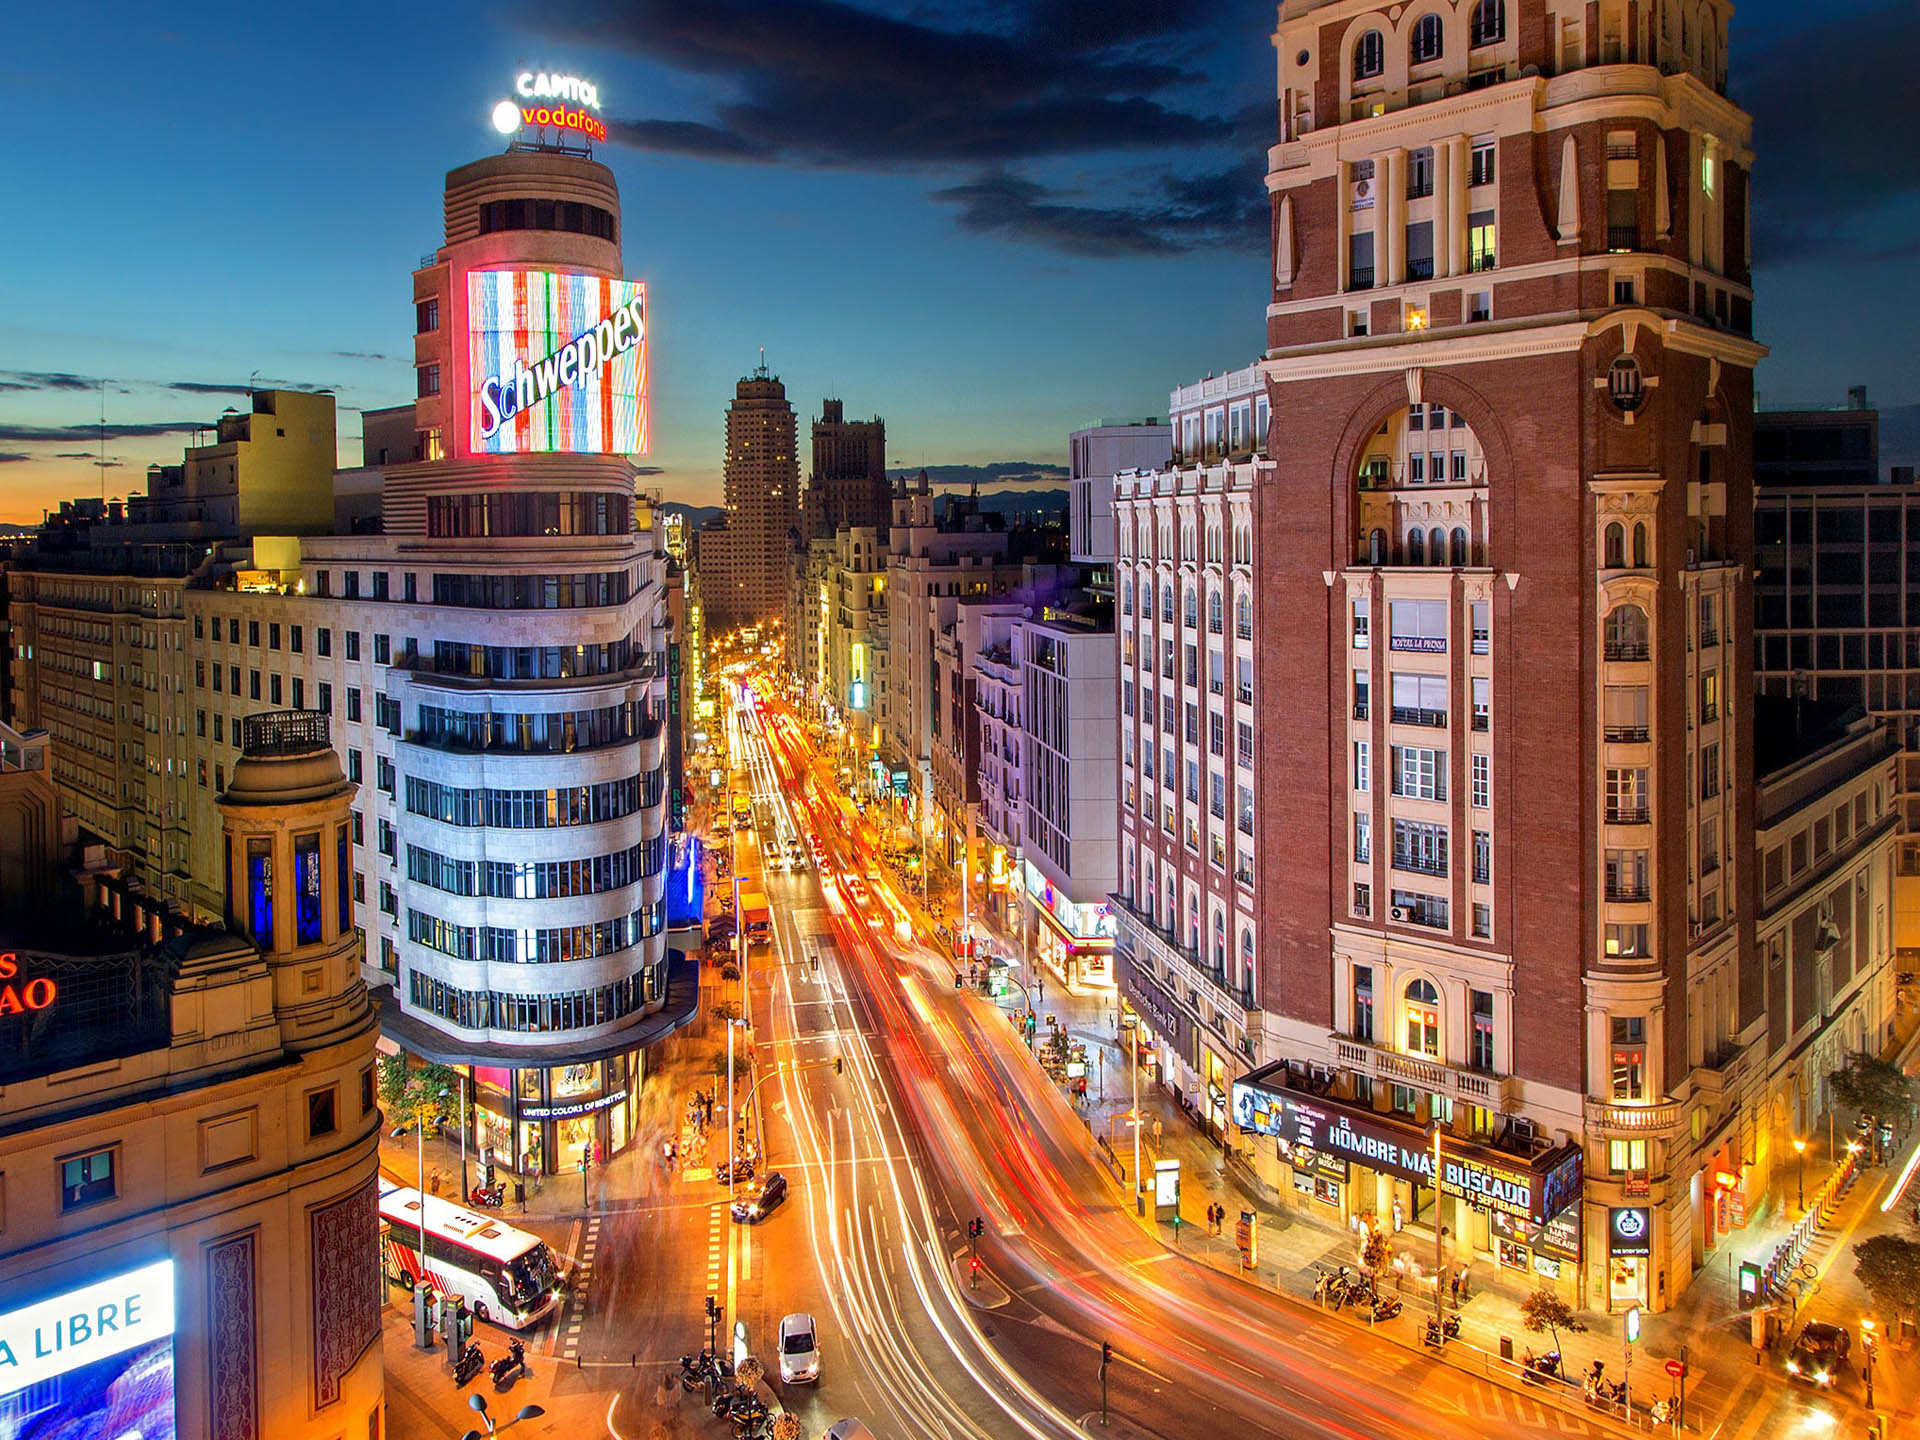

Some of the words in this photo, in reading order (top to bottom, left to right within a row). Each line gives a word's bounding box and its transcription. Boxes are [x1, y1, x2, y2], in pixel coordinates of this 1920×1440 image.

[517, 73, 600, 109] CAPITOL
[521, 104, 606, 143] vodafone
[481, 291, 645, 440] Schweppes
[671, 649, 679, 715] HOTEL
[672, 789, 681, 828] REX
[522, 1108, 550, 1117] UNITED
[551, 1104, 583, 1116] COLORS
[584, 1102, 594, 1111] OF
[1339, 1115, 1351, 1131] EL
[1329, 1125, 1397, 1165] HOMBRE
[1446, 1163, 1531, 1209] BUSCADO
[1427, 1176, 1464, 1197] ESRENO
[1465, 1189, 1476, 1201] 12
[1477, 1193, 1531, 1220] SEPTIEMBRE
[35, 1294, 142, 1359] LIBRE
